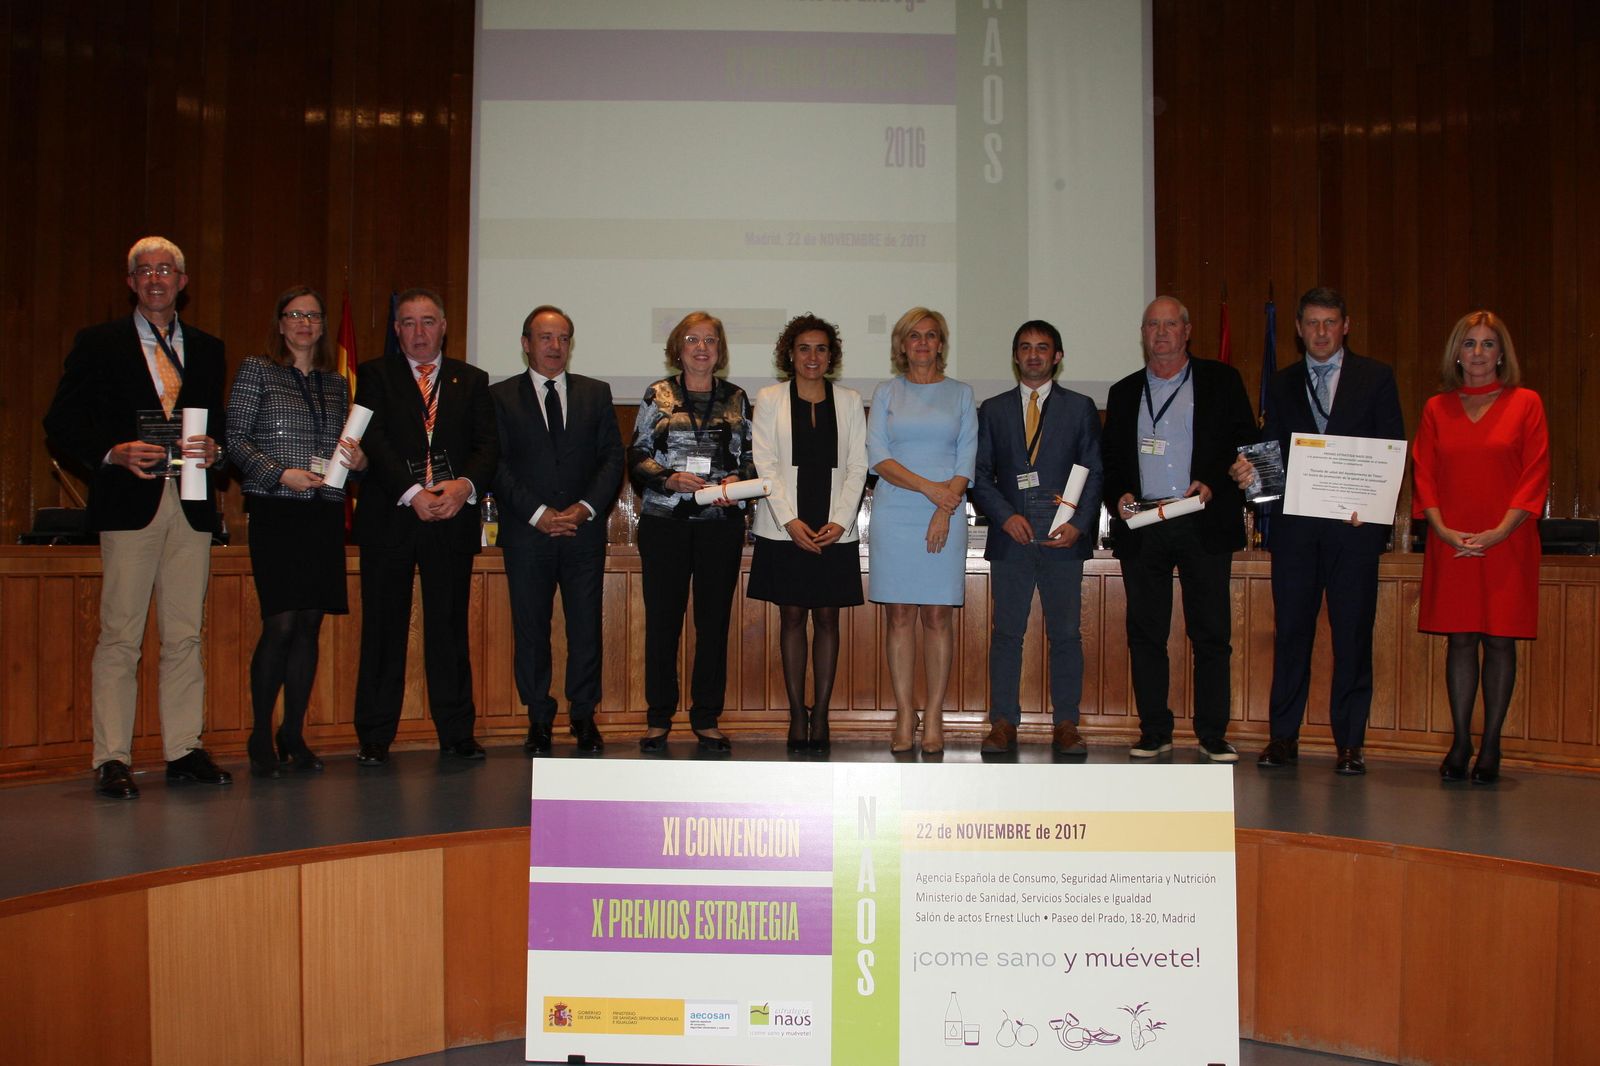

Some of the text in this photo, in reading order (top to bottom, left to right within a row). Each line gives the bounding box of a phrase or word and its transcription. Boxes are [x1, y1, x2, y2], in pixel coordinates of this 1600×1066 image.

[982, 0, 1003, 184] AOS
[885, 126, 926, 169] 2016
[819, 232, 881, 247] NOVIEMBRE
[662, 812, 800, 858] XI CONVENCIÓN
[916, 823, 1087, 840] 22 de NOVIEMBRE de 2017
[916, 872, 1217, 887] Agencia Española de Consumo, Seguridad Alimentaria y Nutrición
[857, 796, 878, 996] NAOS
[915, 891, 1152, 906] Ministerio de Sanidad, Servicios Sociales e Igualdad
[591, 898, 799, 941] X PREMIOS ESTRATEGIA
[915, 911, 1196, 926] Salón de actos Ernest Lluch Paseo del Prado, 18-20, Madrid
[997, 951, 1057, 968] sano
[1064, 952, 1078, 974] y
[1085, 947, 1201, 969] muévete!
[690, 1012, 730, 1020] aecosan
[774, 1014, 812, 1026] naos
